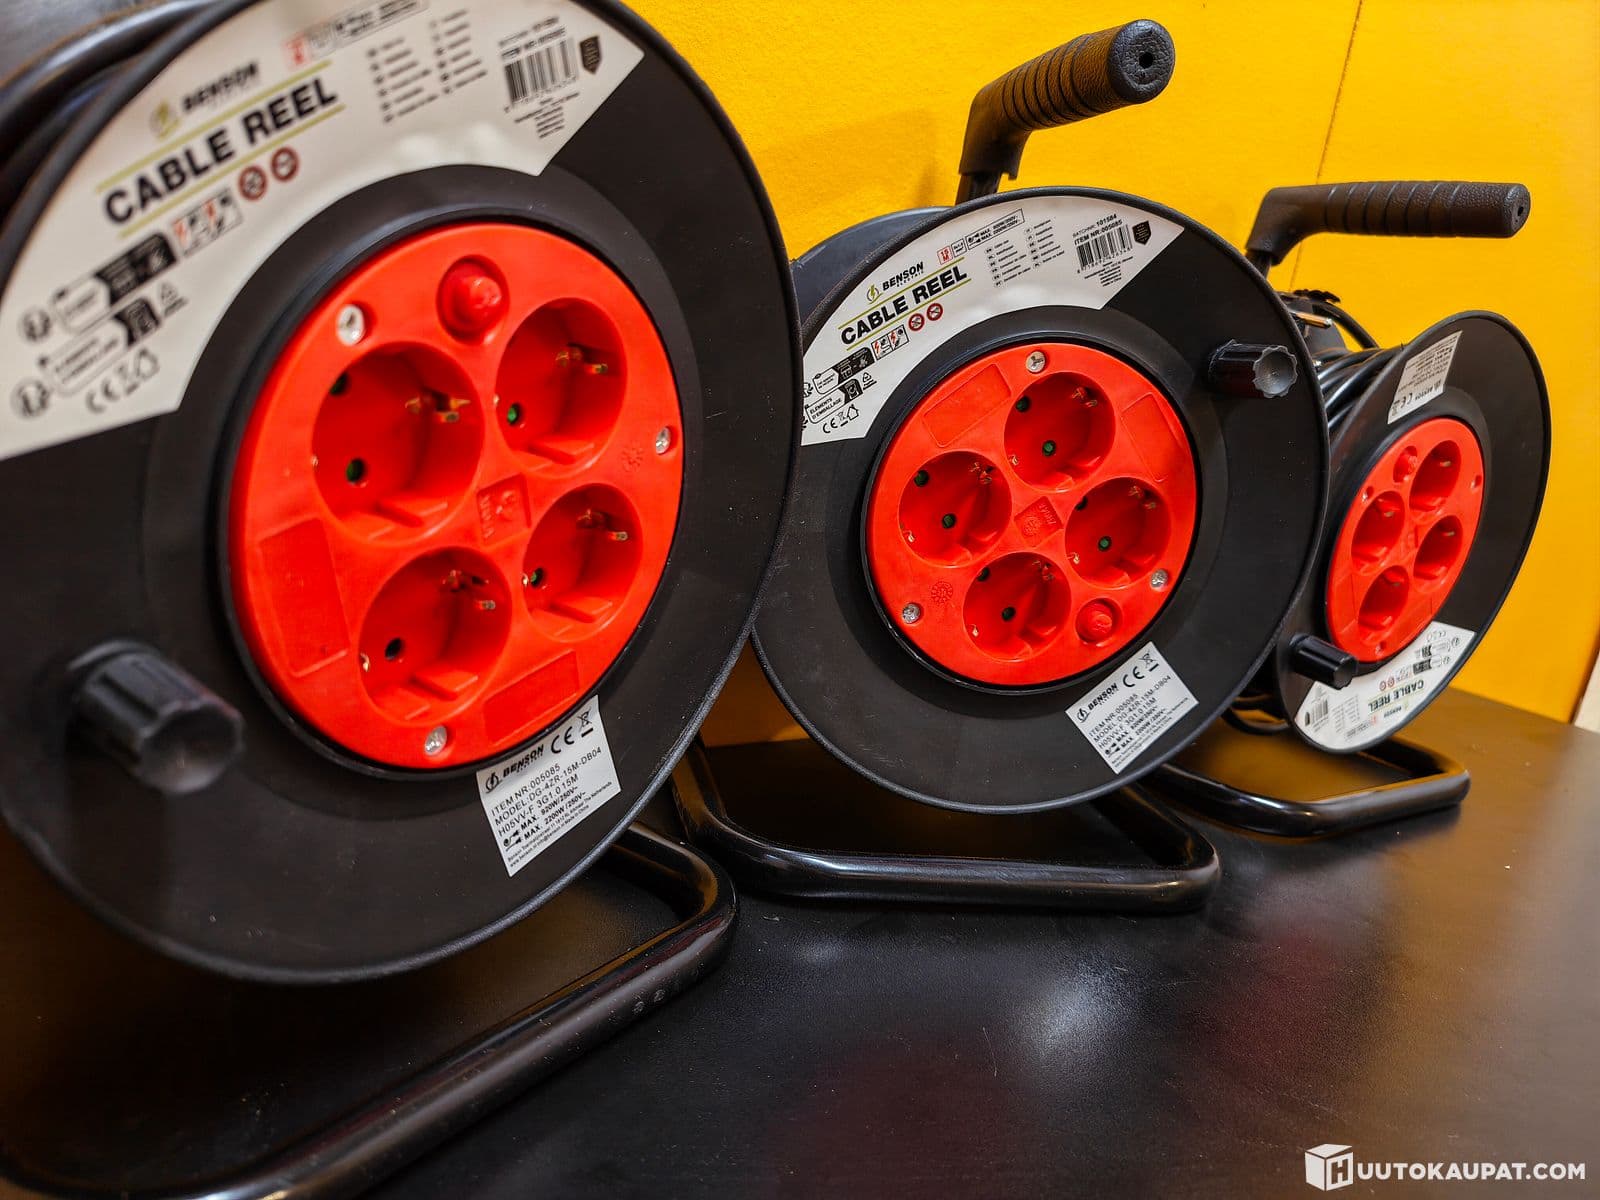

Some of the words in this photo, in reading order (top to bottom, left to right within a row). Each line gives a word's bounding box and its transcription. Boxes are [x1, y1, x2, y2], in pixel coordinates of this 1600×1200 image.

[105, 129, 235, 224] CABLE
[241, 78, 338, 145] REEL
[882, 261, 924, 291] BENSON
[841, 295, 909, 345] CABLE
[912, 266, 968, 304] REEL
[1087, 682, 1118, 710] BENSON
[1368, 694, 1391, 712] REEL
[1394, 679, 1425, 700] CABLE
[1088, 721, 1105, 737] ITEM
[502, 744, 544, 778] BENSON
[497, 804, 535, 837] H05VV-F
[562, 772, 578, 790] 15M
